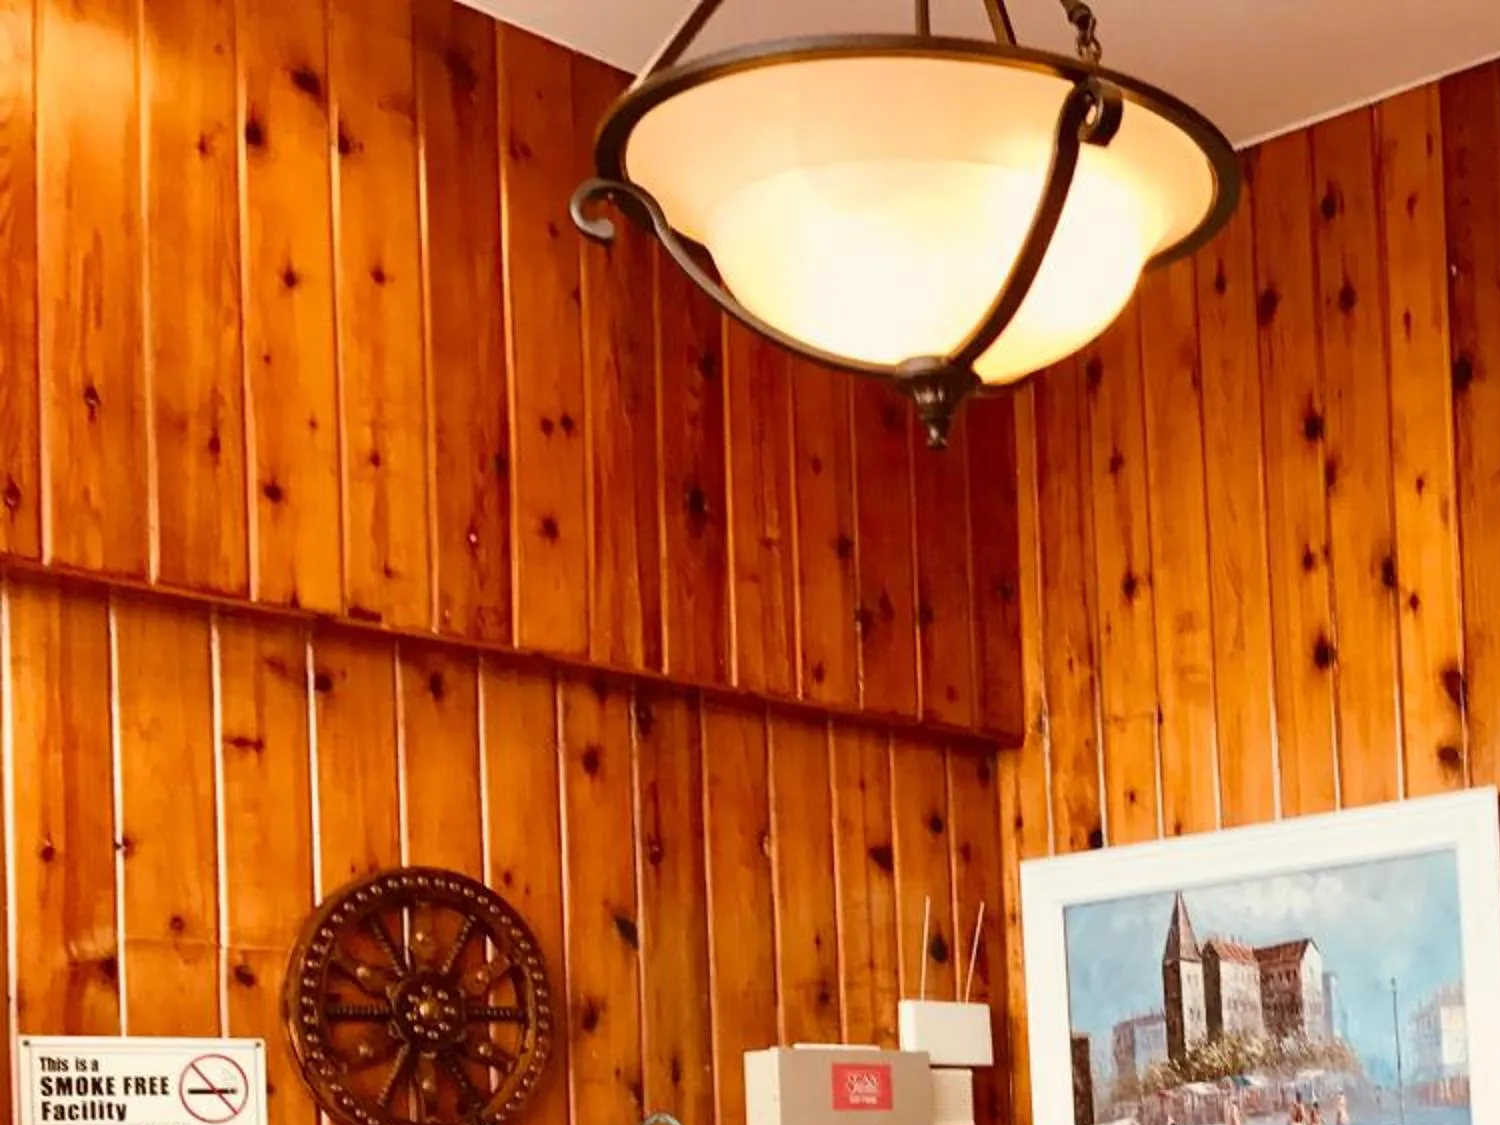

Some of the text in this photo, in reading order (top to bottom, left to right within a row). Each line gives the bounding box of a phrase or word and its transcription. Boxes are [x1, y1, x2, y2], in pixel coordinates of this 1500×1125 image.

[39, 1057, 98, 1072] This is a
[40, 1077, 169, 1096] SMOKE FREE
[41, 1101, 127, 1122] Facility
